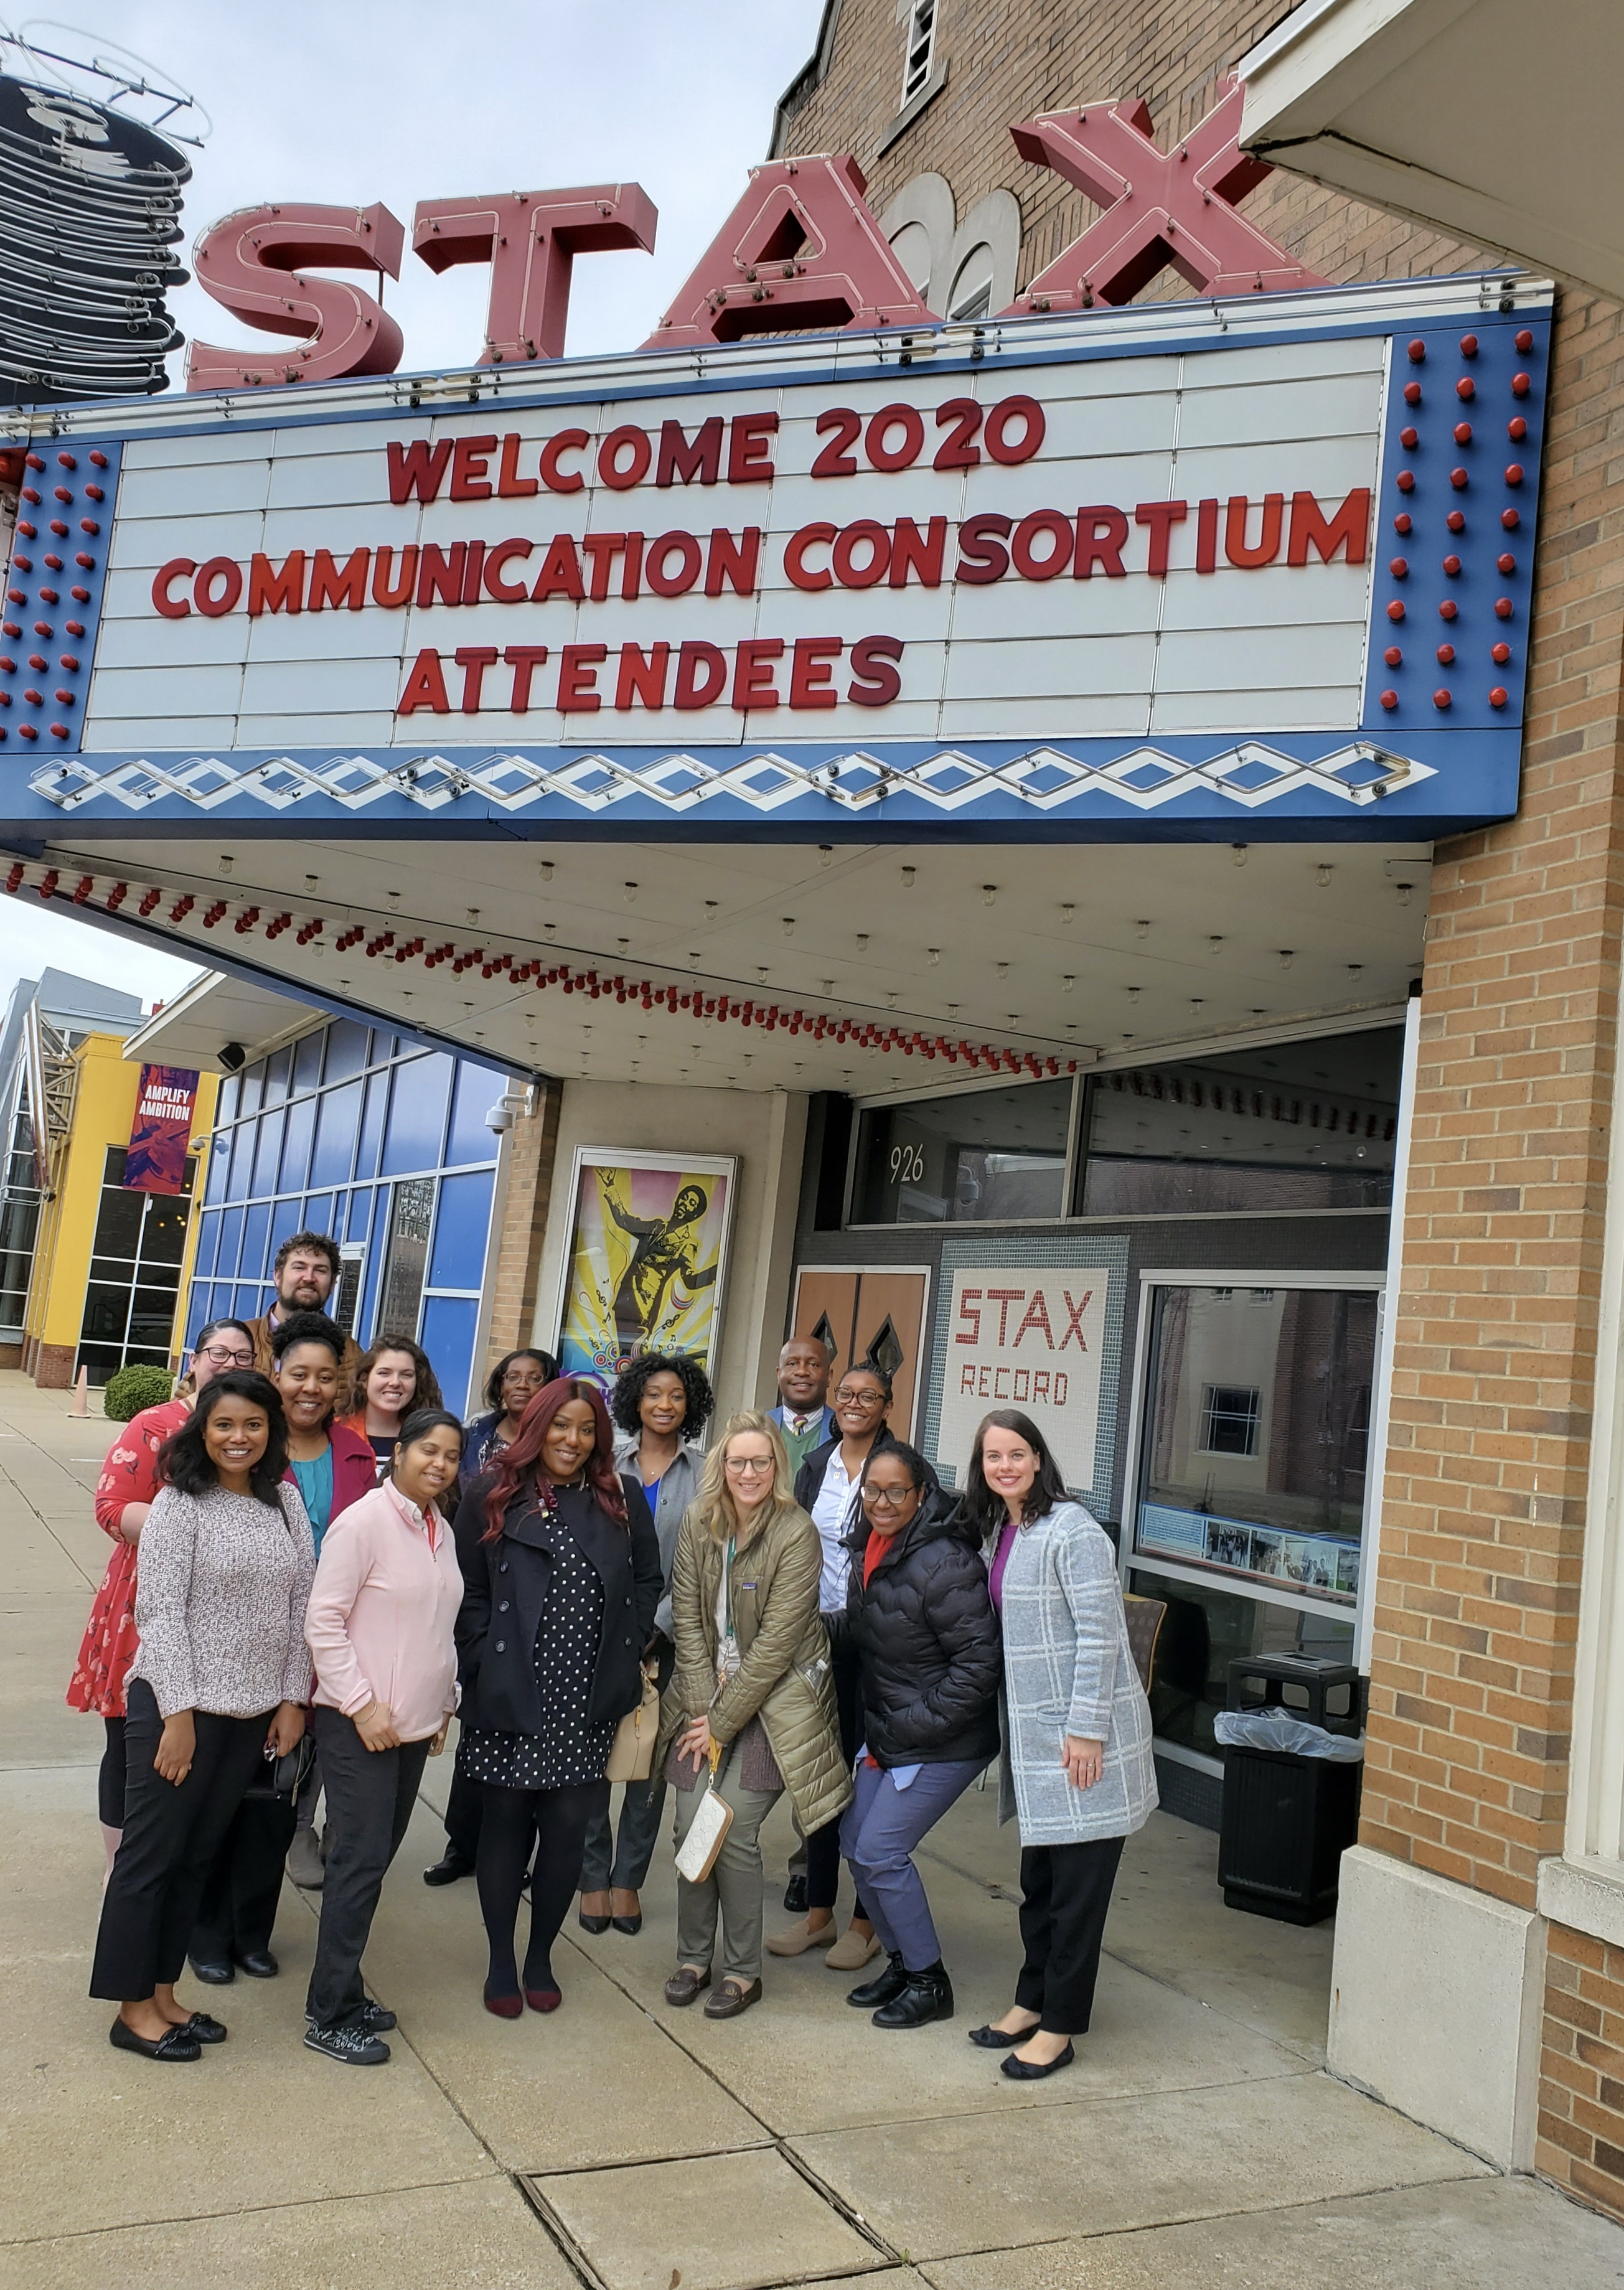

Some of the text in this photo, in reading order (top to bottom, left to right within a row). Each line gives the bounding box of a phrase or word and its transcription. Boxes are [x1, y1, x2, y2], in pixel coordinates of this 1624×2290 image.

[184, 71, 1336, 393] STAX
[387, 395, 1045, 504] WELCOME 2020
[152, 488, 1371, 619] COMMUNICATION CONSORTIUM
[396, 636, 904, 715] ATTENDEES
[139, 1100, 190, 1121] AMBITION
[145, 1084, 190, 1104] AMPLIFY
[890, 1143, 924, 1184] 926
[955, 1289, 1093, 1352] STAX
[960, 1364, 1068, 1406] RECORD
